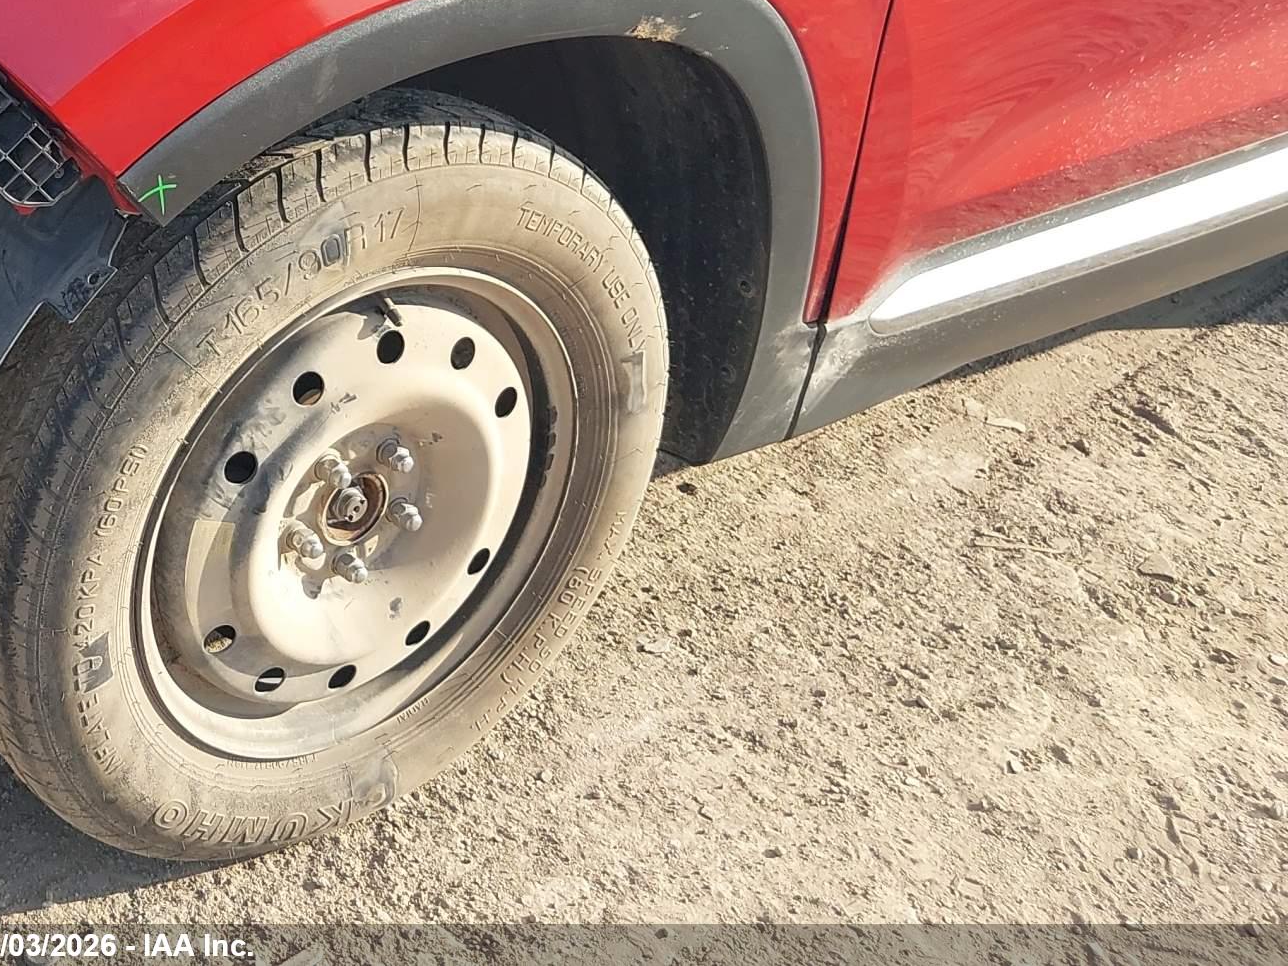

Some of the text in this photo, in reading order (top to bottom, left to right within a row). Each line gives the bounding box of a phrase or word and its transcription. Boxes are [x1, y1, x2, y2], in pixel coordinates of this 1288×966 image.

[517, 206, 647, 355] TEMPORARY USE ONLY
[553, 567, 602, 639] SPEED
[528, 648, 552, 674] 50
[77, 692, 125, 775] INFLATE
[151, 797, 353, 844] KUMHO
